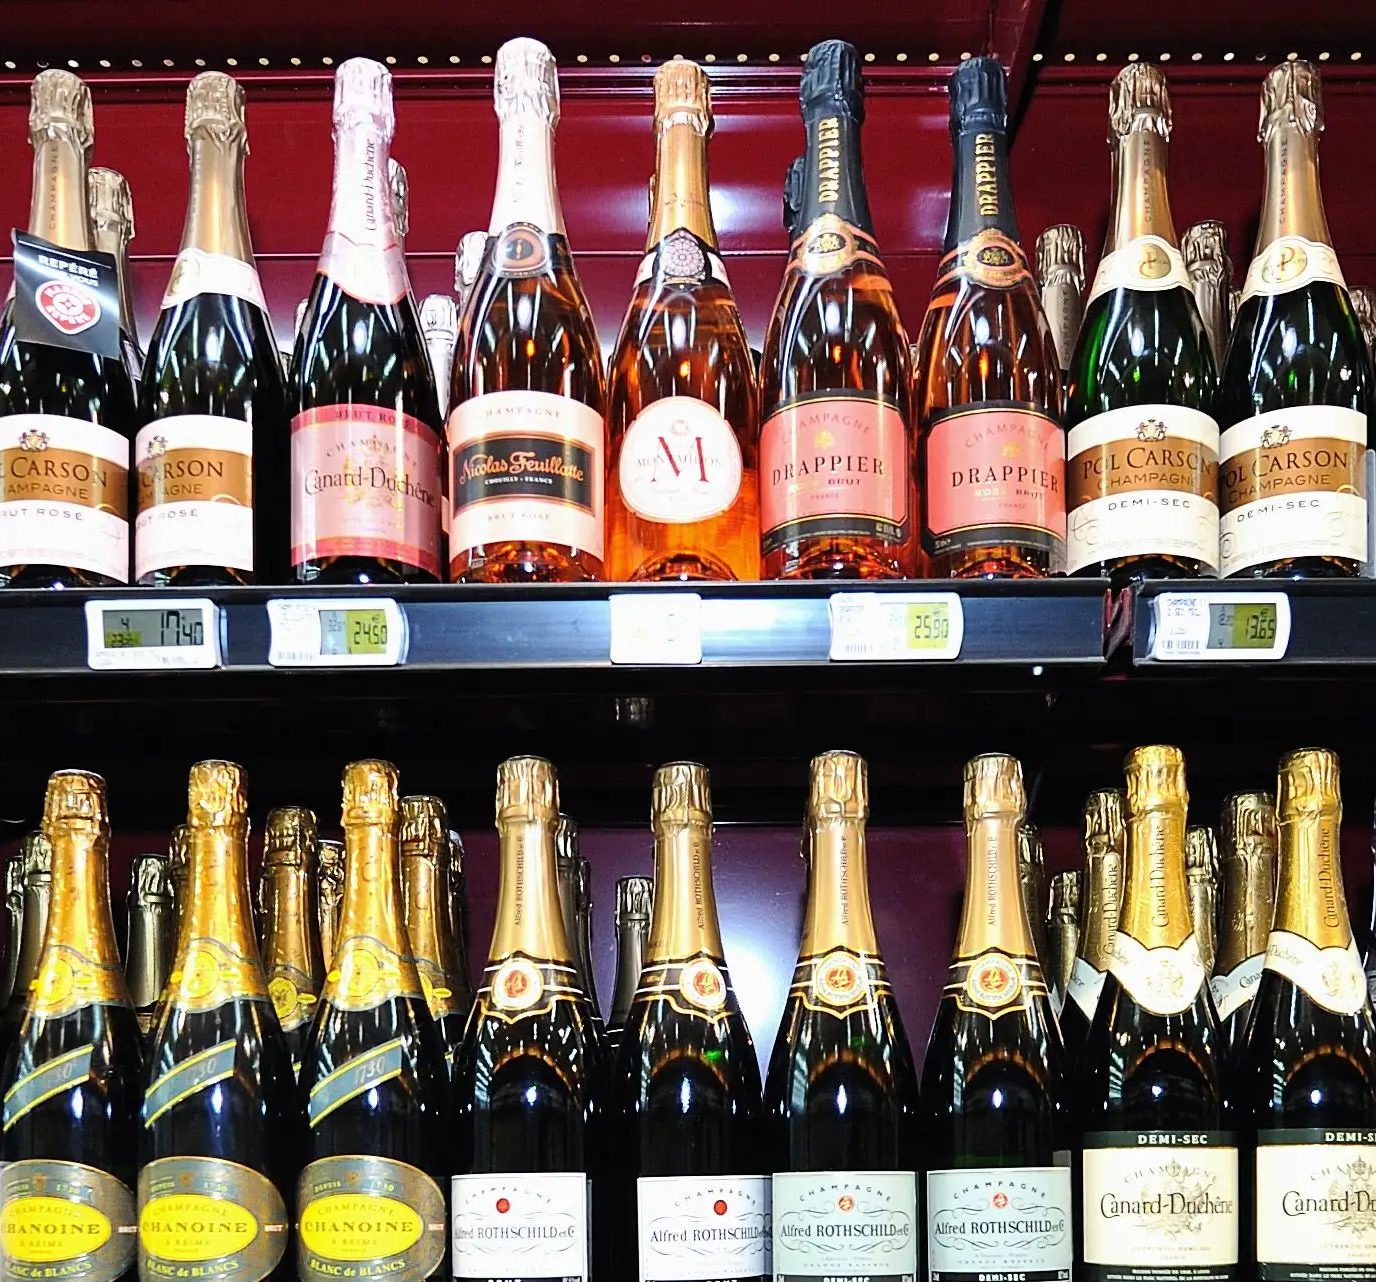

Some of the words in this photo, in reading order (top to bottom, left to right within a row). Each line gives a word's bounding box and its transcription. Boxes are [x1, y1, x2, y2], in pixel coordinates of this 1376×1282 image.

[818, 117, 839, 204] DRAPPIER
[979, 132, 996, 216] DRAPPIER
[10, 456, 108, 488] CARSON
[459, 454, 509, 484] Nicolas
[772, 455, 886, 487] DRAPPIER
[1083, 457, 1121, 480] POL
[1251, 451, 1349, 477] CARSON
[827, 477, 861, 487] BRUT
[951, 465, 1059, 494] DRAPPIER
[1229, 473, 1330, 504] CHAMPAGNE
[1108, 496, 1191, 512] DEMI-SEC
[1237, 498, 1320, 523] DEMI-SEC
[1137, 1133, 1208, 1146] DEMI-SEC
[799, 1183, 892, 1203] CHAMPAGNE
[953, 1180, 1047, 1199] CHAMPAGNE
[305, 1219, 414, 1233] CHANOINE
[477, 1226, 557, 1239] ROTHSCHILD
[650, 1229, 688, 1242] Alfred
[780, 1225, 812, 1238] Alfred
[815, 1224, 897, 1238] ROTHSCHILD
[934, 1220, 966, 1235] Alfred
[971, 1219, 1051, 1234] ROTHSCHILD
[176, 1269, 189, 1277] de
[191, 1259, 239, 1277] BLANCS
[310, 1258, 342, 1275] BLANC
[344, 1265, 356, 1276] de
[360, 1258, 406, 1276] BLANCS
[978, 1273, 1027, 1282] DEMI-SEC
